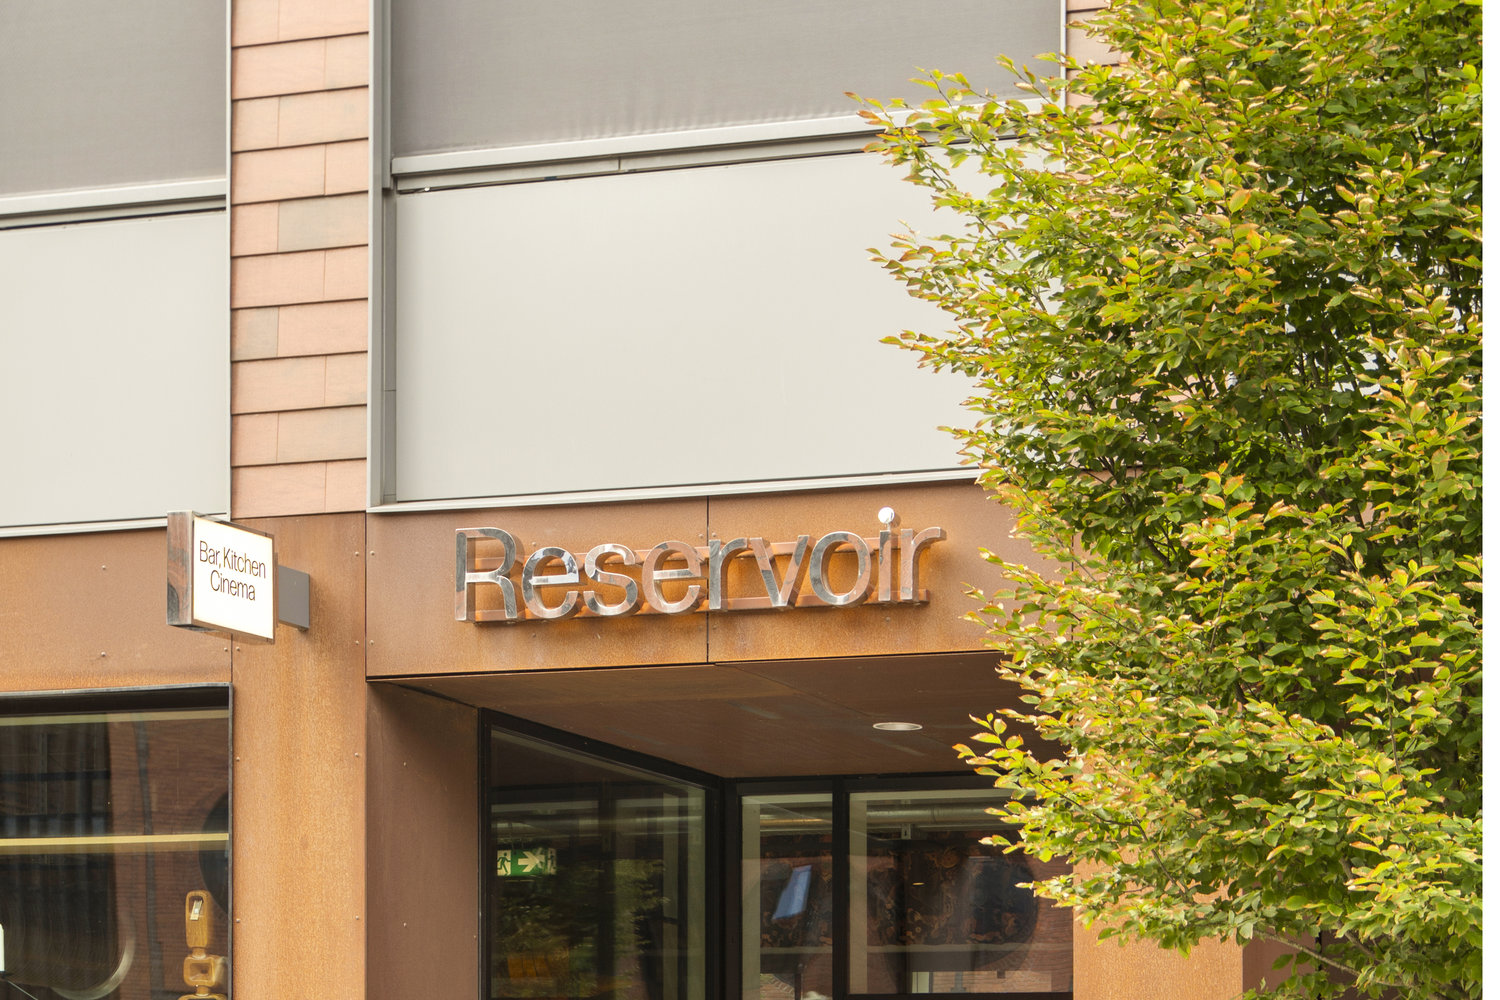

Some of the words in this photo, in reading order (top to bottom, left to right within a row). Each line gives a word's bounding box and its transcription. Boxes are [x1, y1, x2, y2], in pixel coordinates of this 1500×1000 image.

[200, 540, 221, 569] Bar,
[223, 547, 266, 579] Kitchen
[455, 507, 947, 622] Reservoir
[211, 570, 256, 601] Cinema
